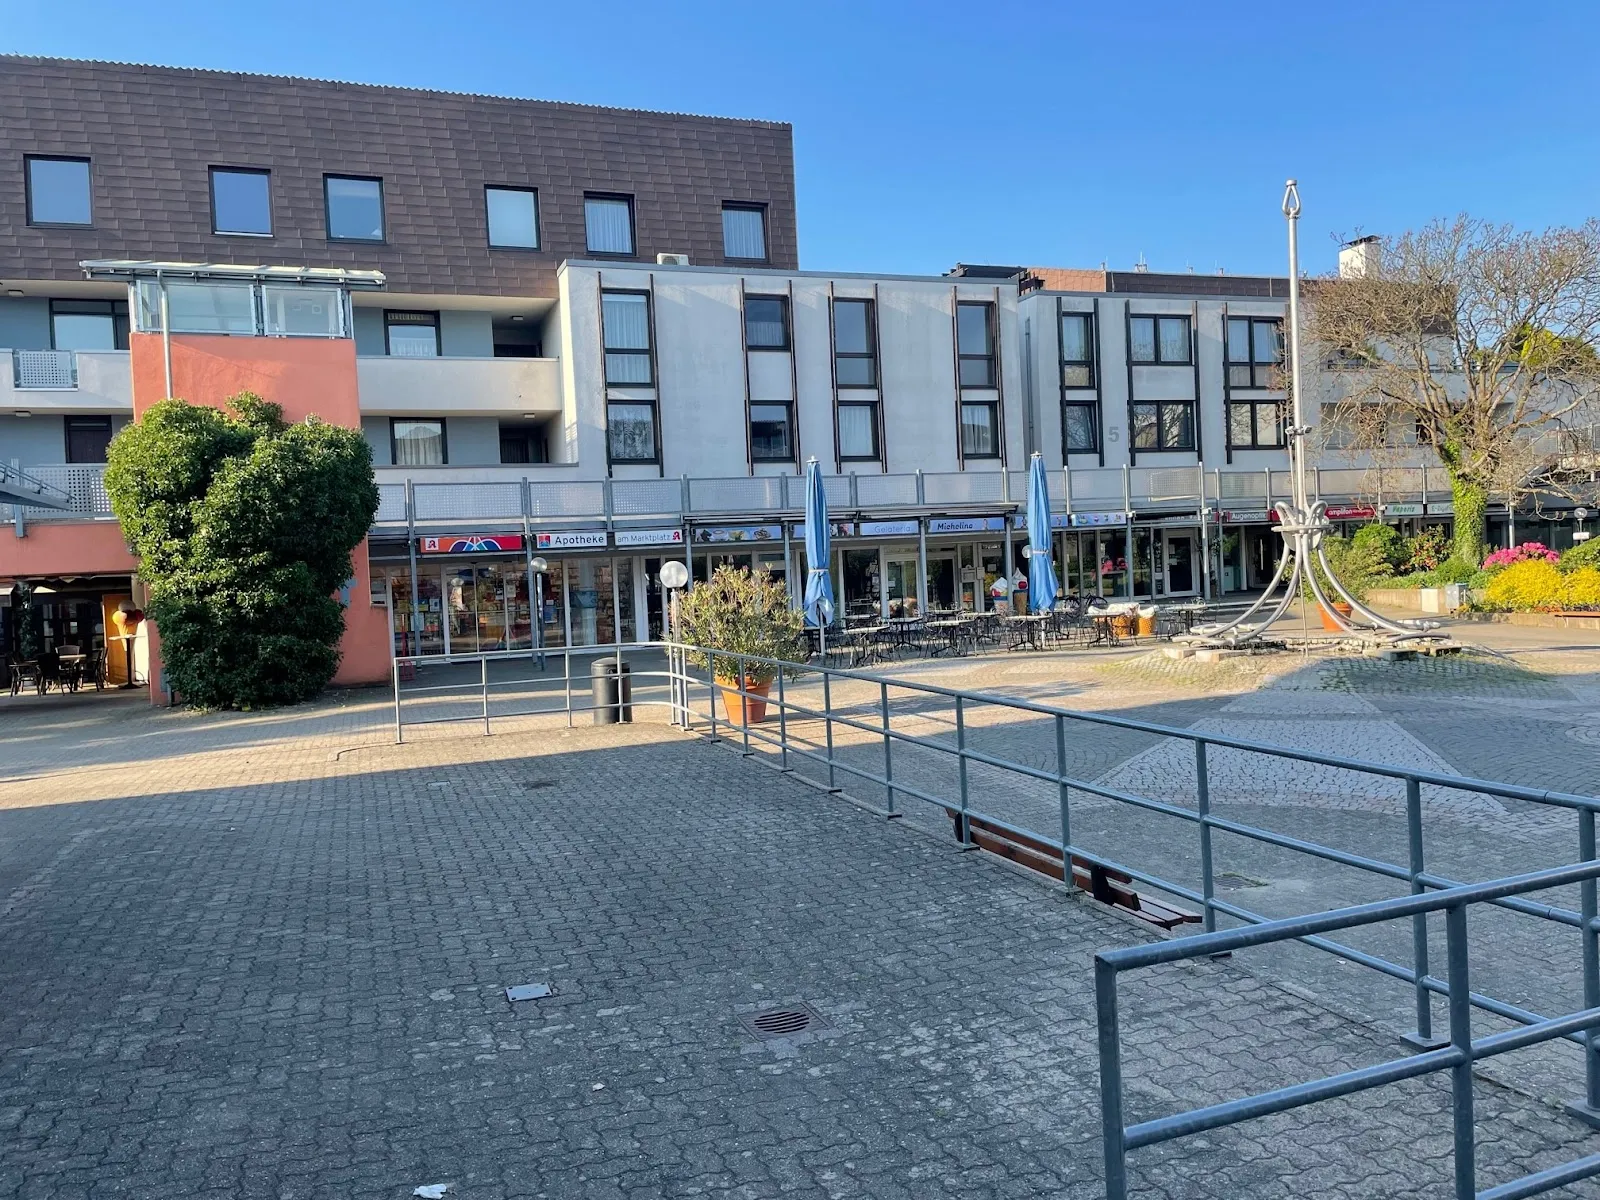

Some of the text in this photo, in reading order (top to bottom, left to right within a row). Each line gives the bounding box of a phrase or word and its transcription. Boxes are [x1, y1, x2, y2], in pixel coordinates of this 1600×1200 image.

[1108, 426, 1119, 442] 5
[874, 525, 911, 534] Gelateria
[555, 535, 604, 546] Apotheke
[631, 533, 671, 543] Marktplatz
